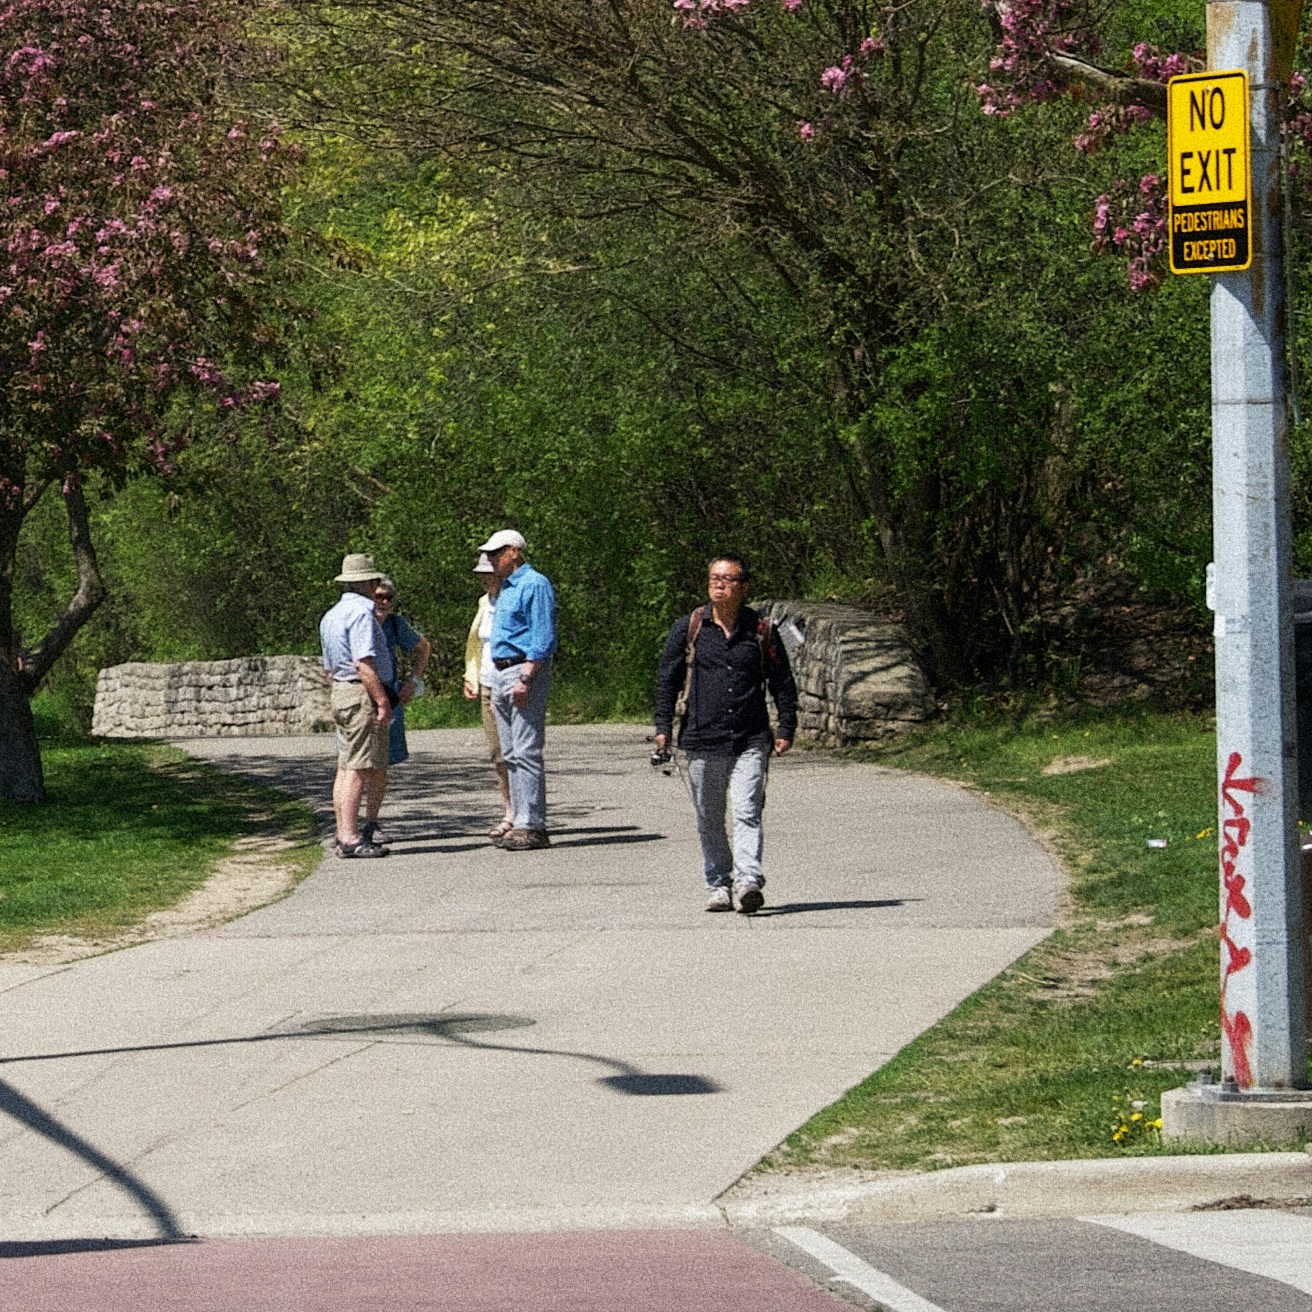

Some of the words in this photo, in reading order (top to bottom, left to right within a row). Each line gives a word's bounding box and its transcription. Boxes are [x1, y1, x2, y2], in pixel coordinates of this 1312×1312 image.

[1189, 86, 1225, 132] NO
[1180, 148, 1236, 194] EXIT
[1173, 208, 1245, 233] PEDESTRIANS
[1183, 238, 1236, 262] EXCEPTED
